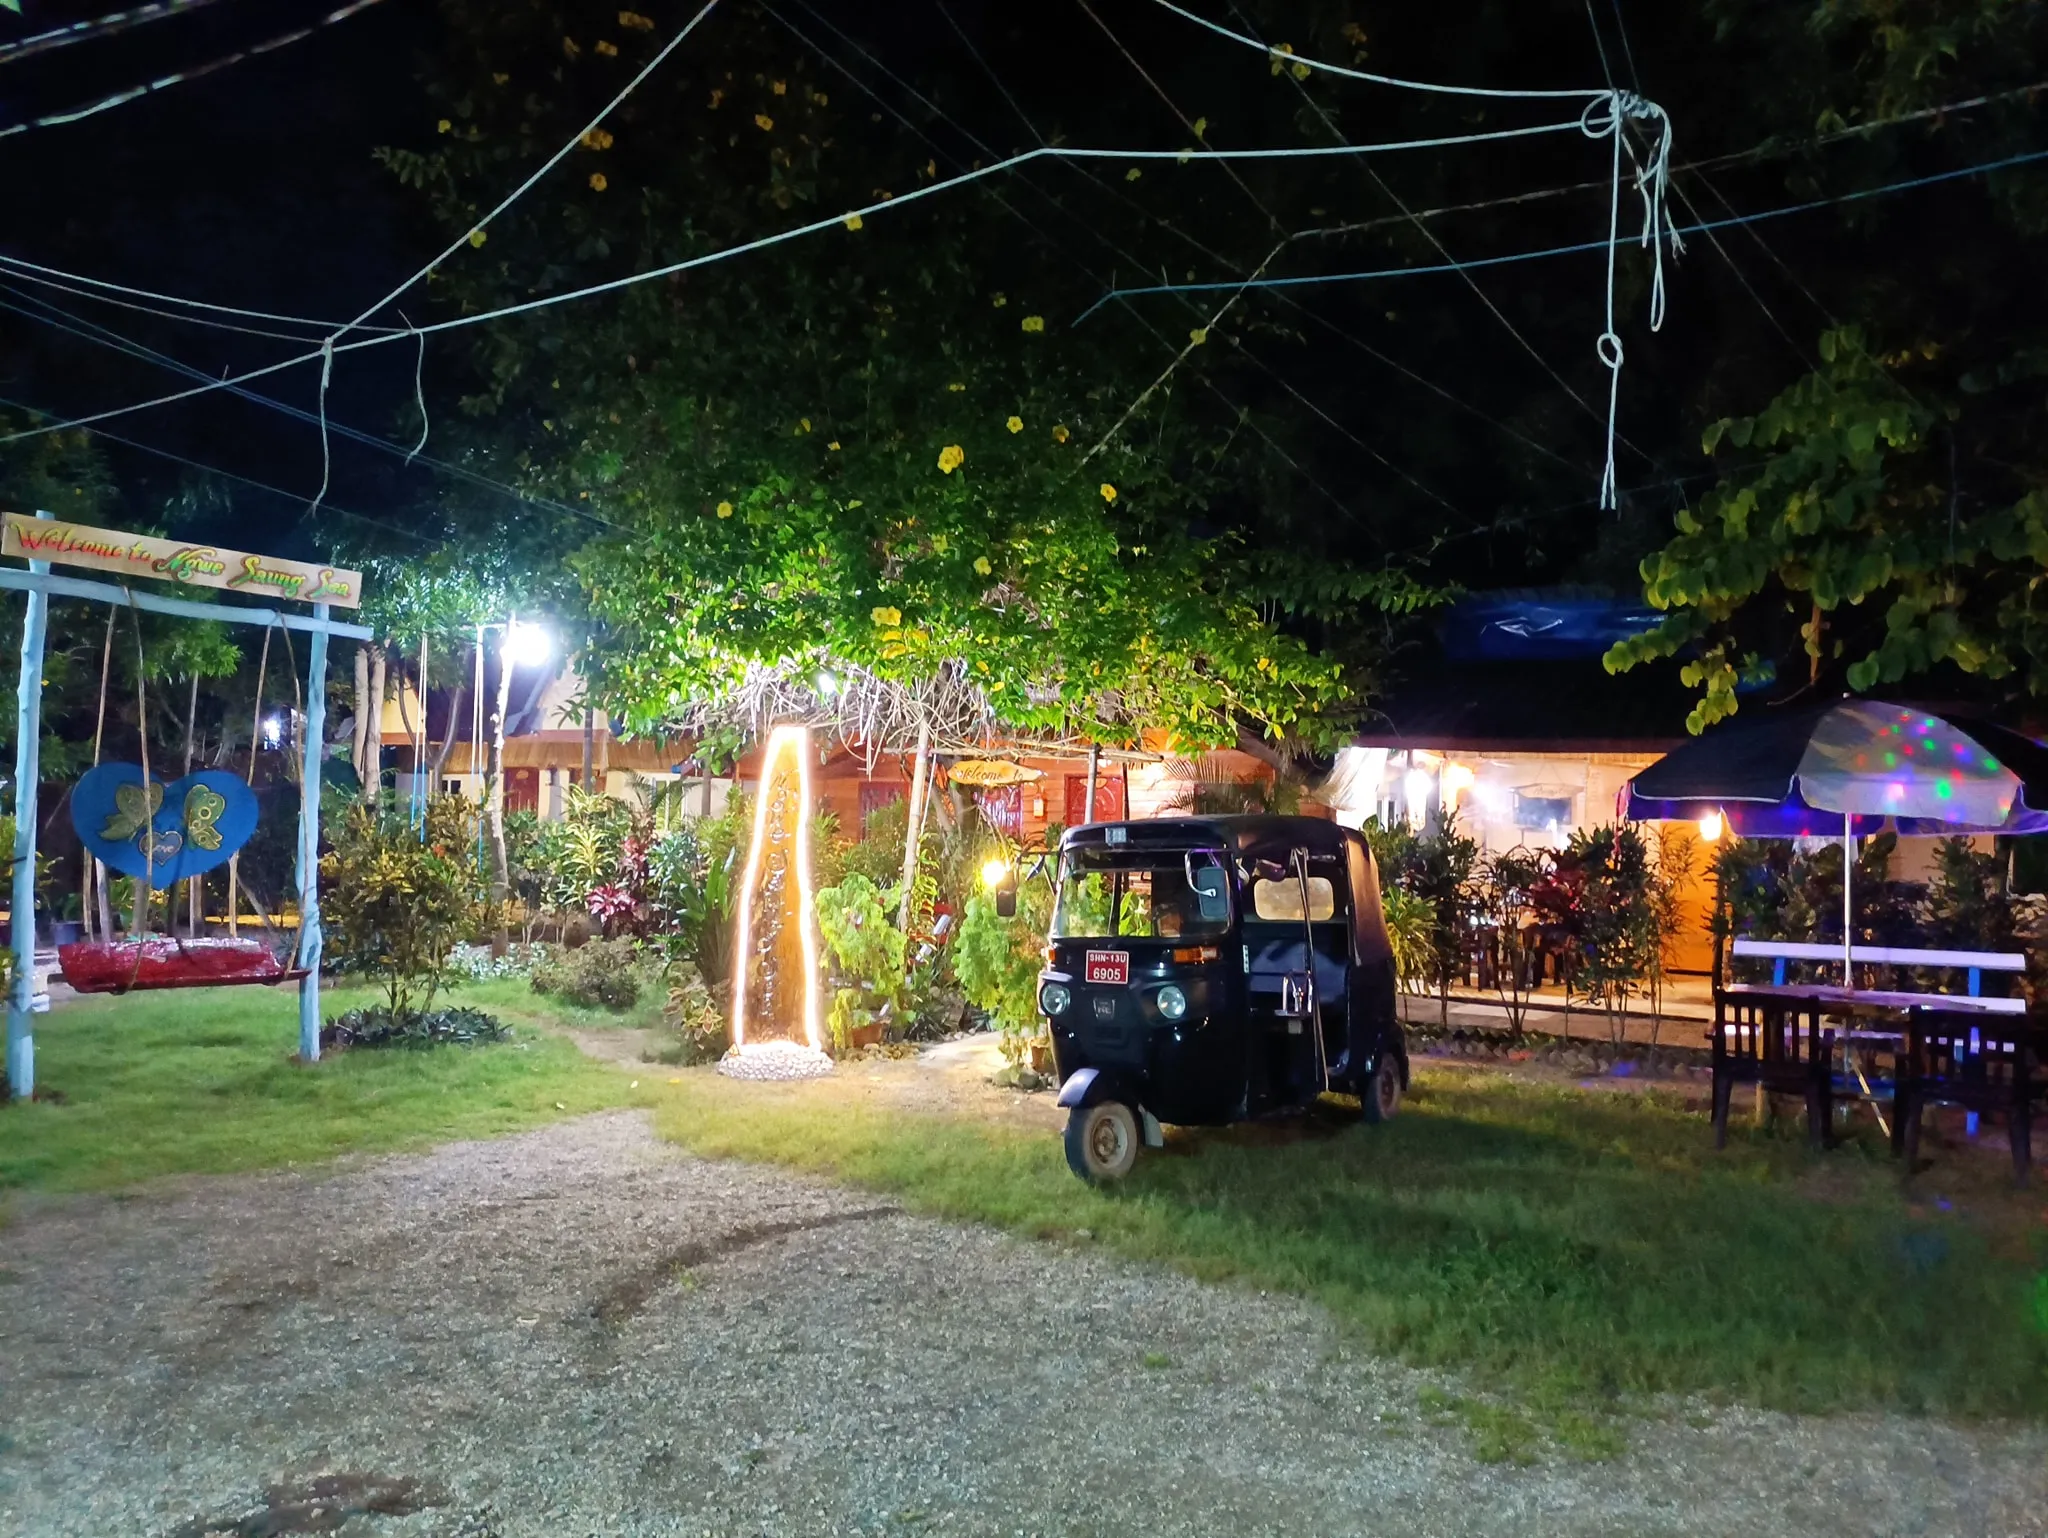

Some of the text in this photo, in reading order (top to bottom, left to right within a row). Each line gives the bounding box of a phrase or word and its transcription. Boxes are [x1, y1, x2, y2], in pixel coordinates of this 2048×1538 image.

[9, 522, 352, 600] Welcome to Ngwe Saung Sea
[1089, 953, 1127, 963] SHN-13U
[1093, 967, 1121, 981] 6905
